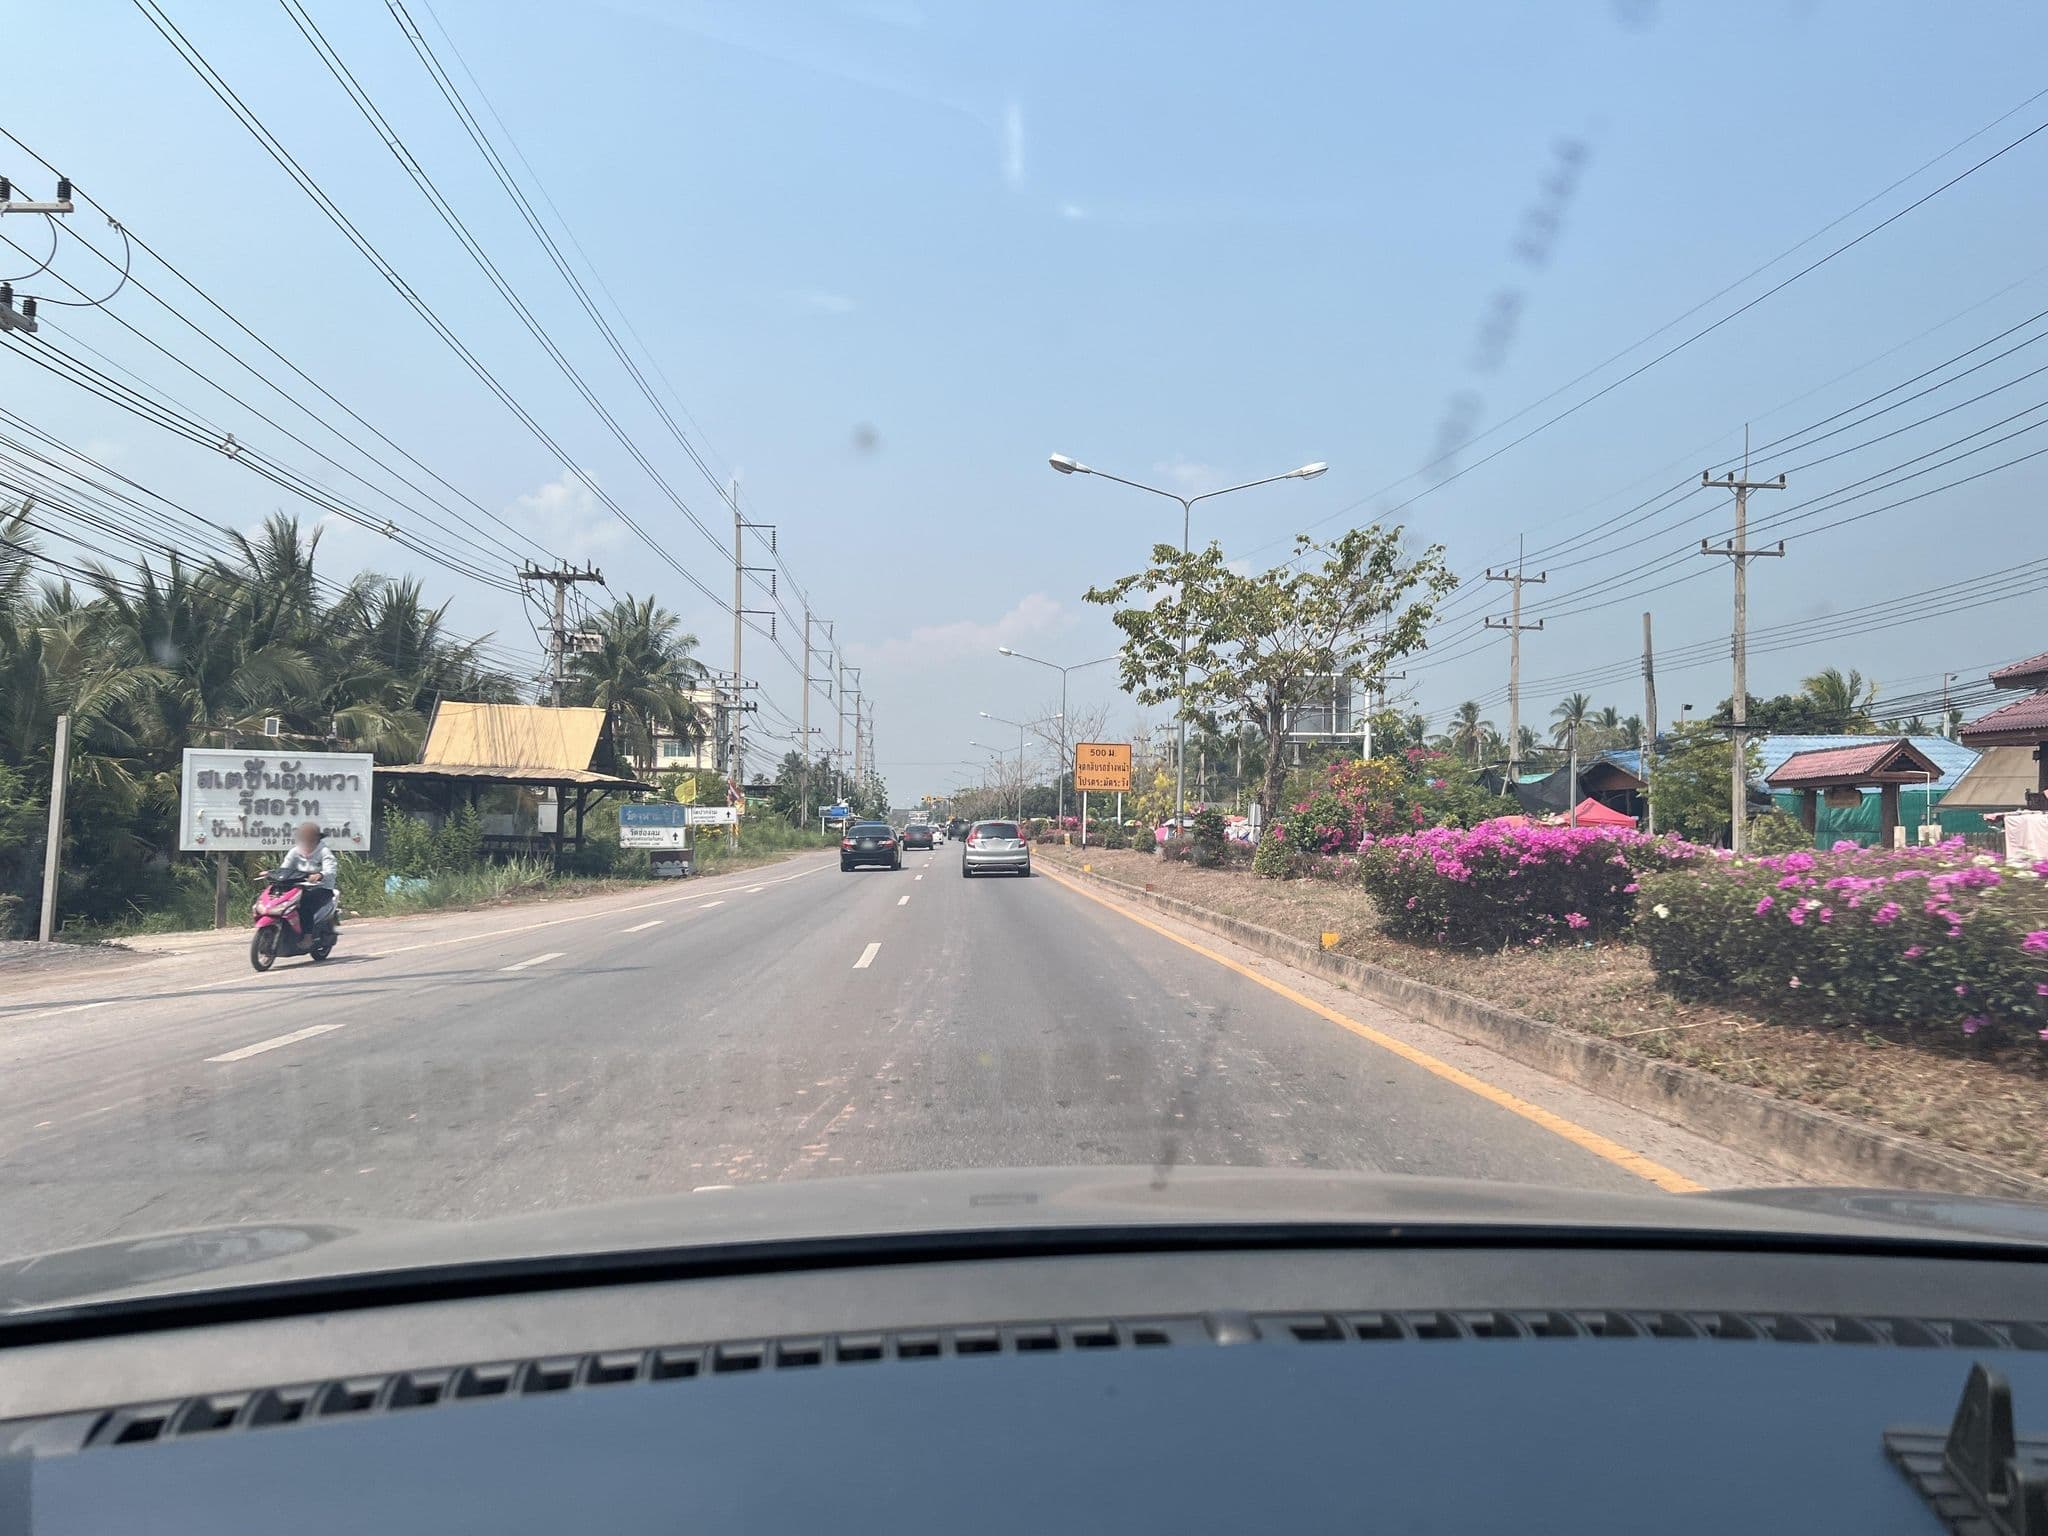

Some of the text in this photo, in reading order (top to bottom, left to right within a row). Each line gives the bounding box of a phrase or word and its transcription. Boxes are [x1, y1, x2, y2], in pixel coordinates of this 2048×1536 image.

[1090, 748, 1107, 757] 500
[1077, 776, 1129, 787] โปรดระมัดระวัง
[238, 790, 320, 816] รีสอร์ท
